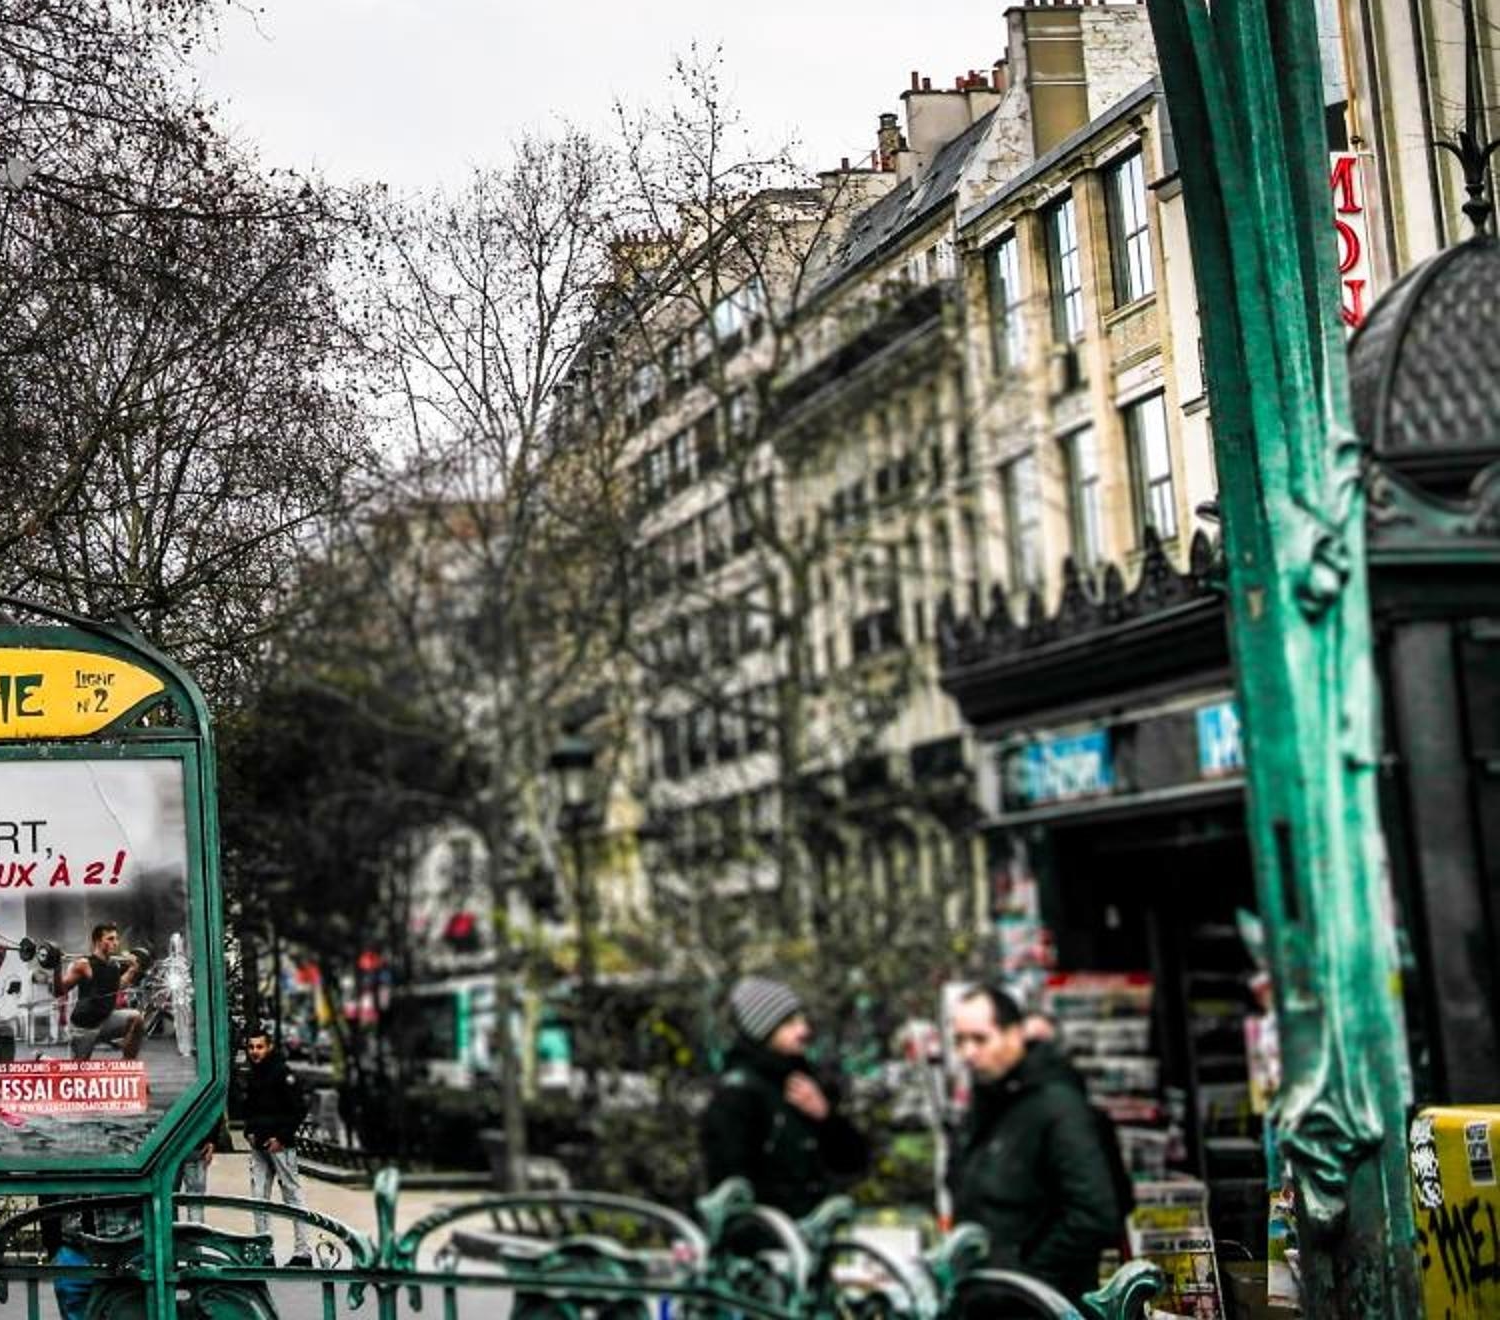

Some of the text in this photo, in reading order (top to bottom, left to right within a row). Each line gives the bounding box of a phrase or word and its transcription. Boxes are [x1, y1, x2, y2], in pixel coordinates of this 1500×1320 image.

[49, 854, 71, 887] À
[1, 1077, 141, 1101] ESSAI GRATUIT
